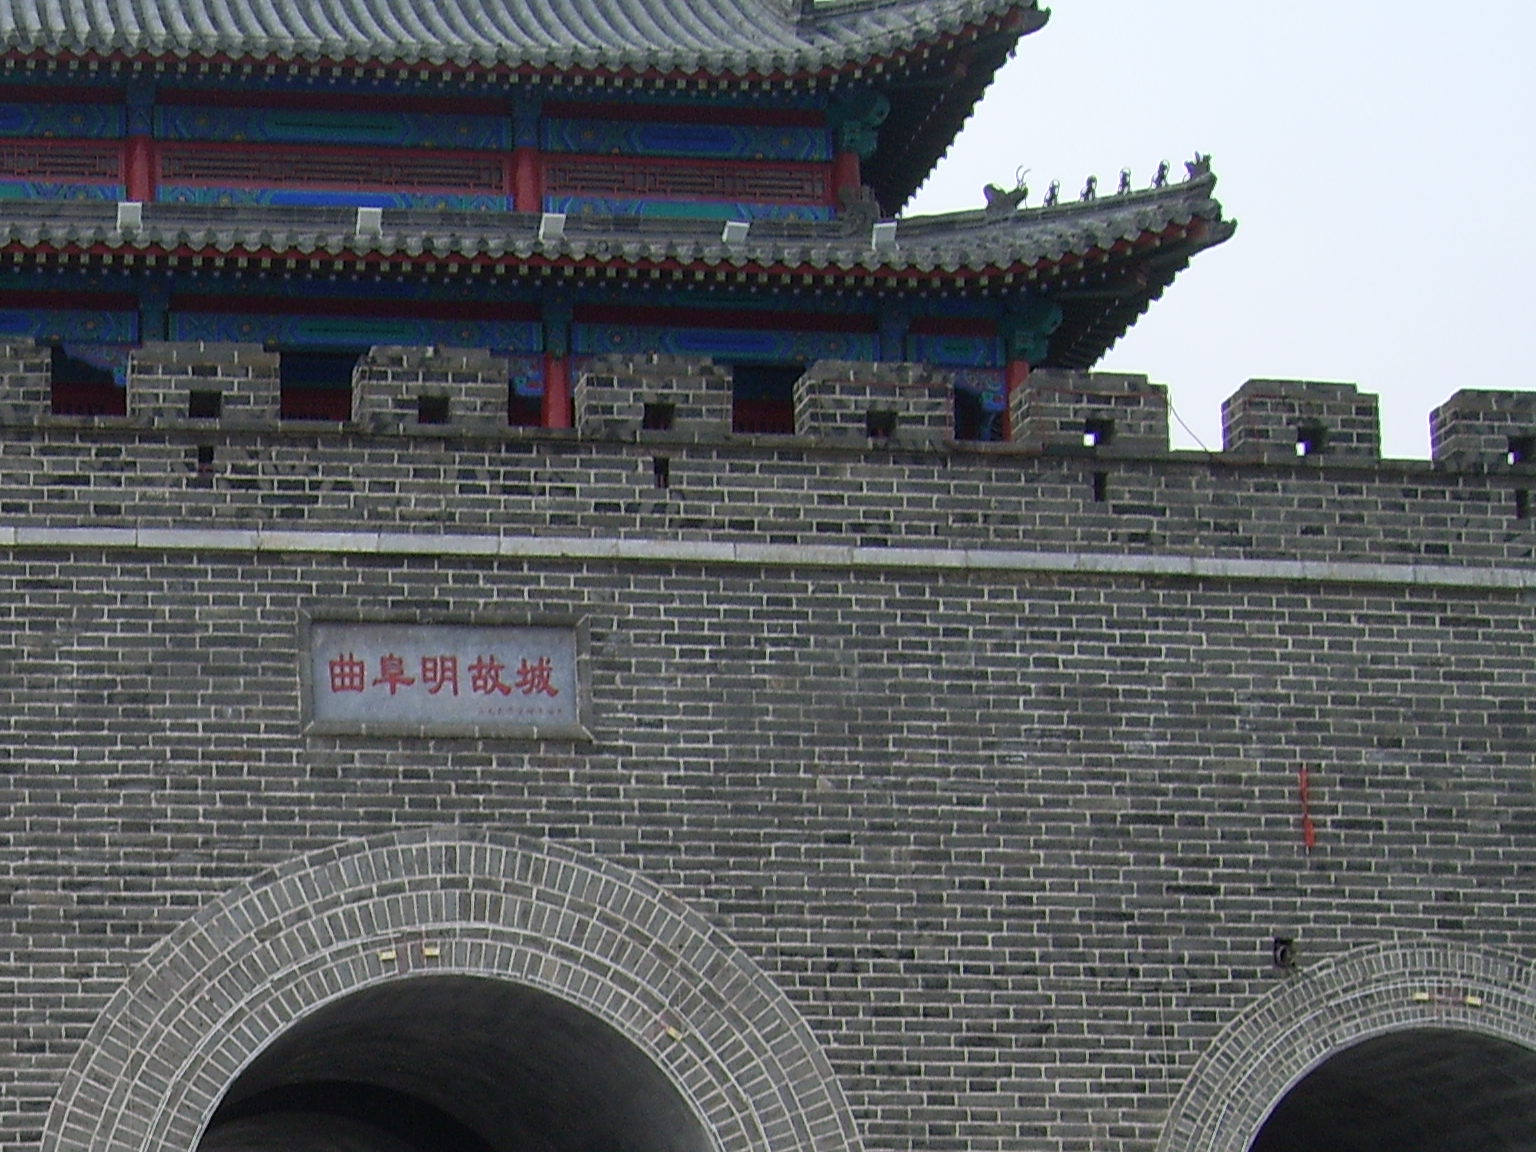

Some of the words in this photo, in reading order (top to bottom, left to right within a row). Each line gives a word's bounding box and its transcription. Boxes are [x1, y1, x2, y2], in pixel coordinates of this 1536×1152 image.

[329, 653, 559, 697] 曲阜明故城
